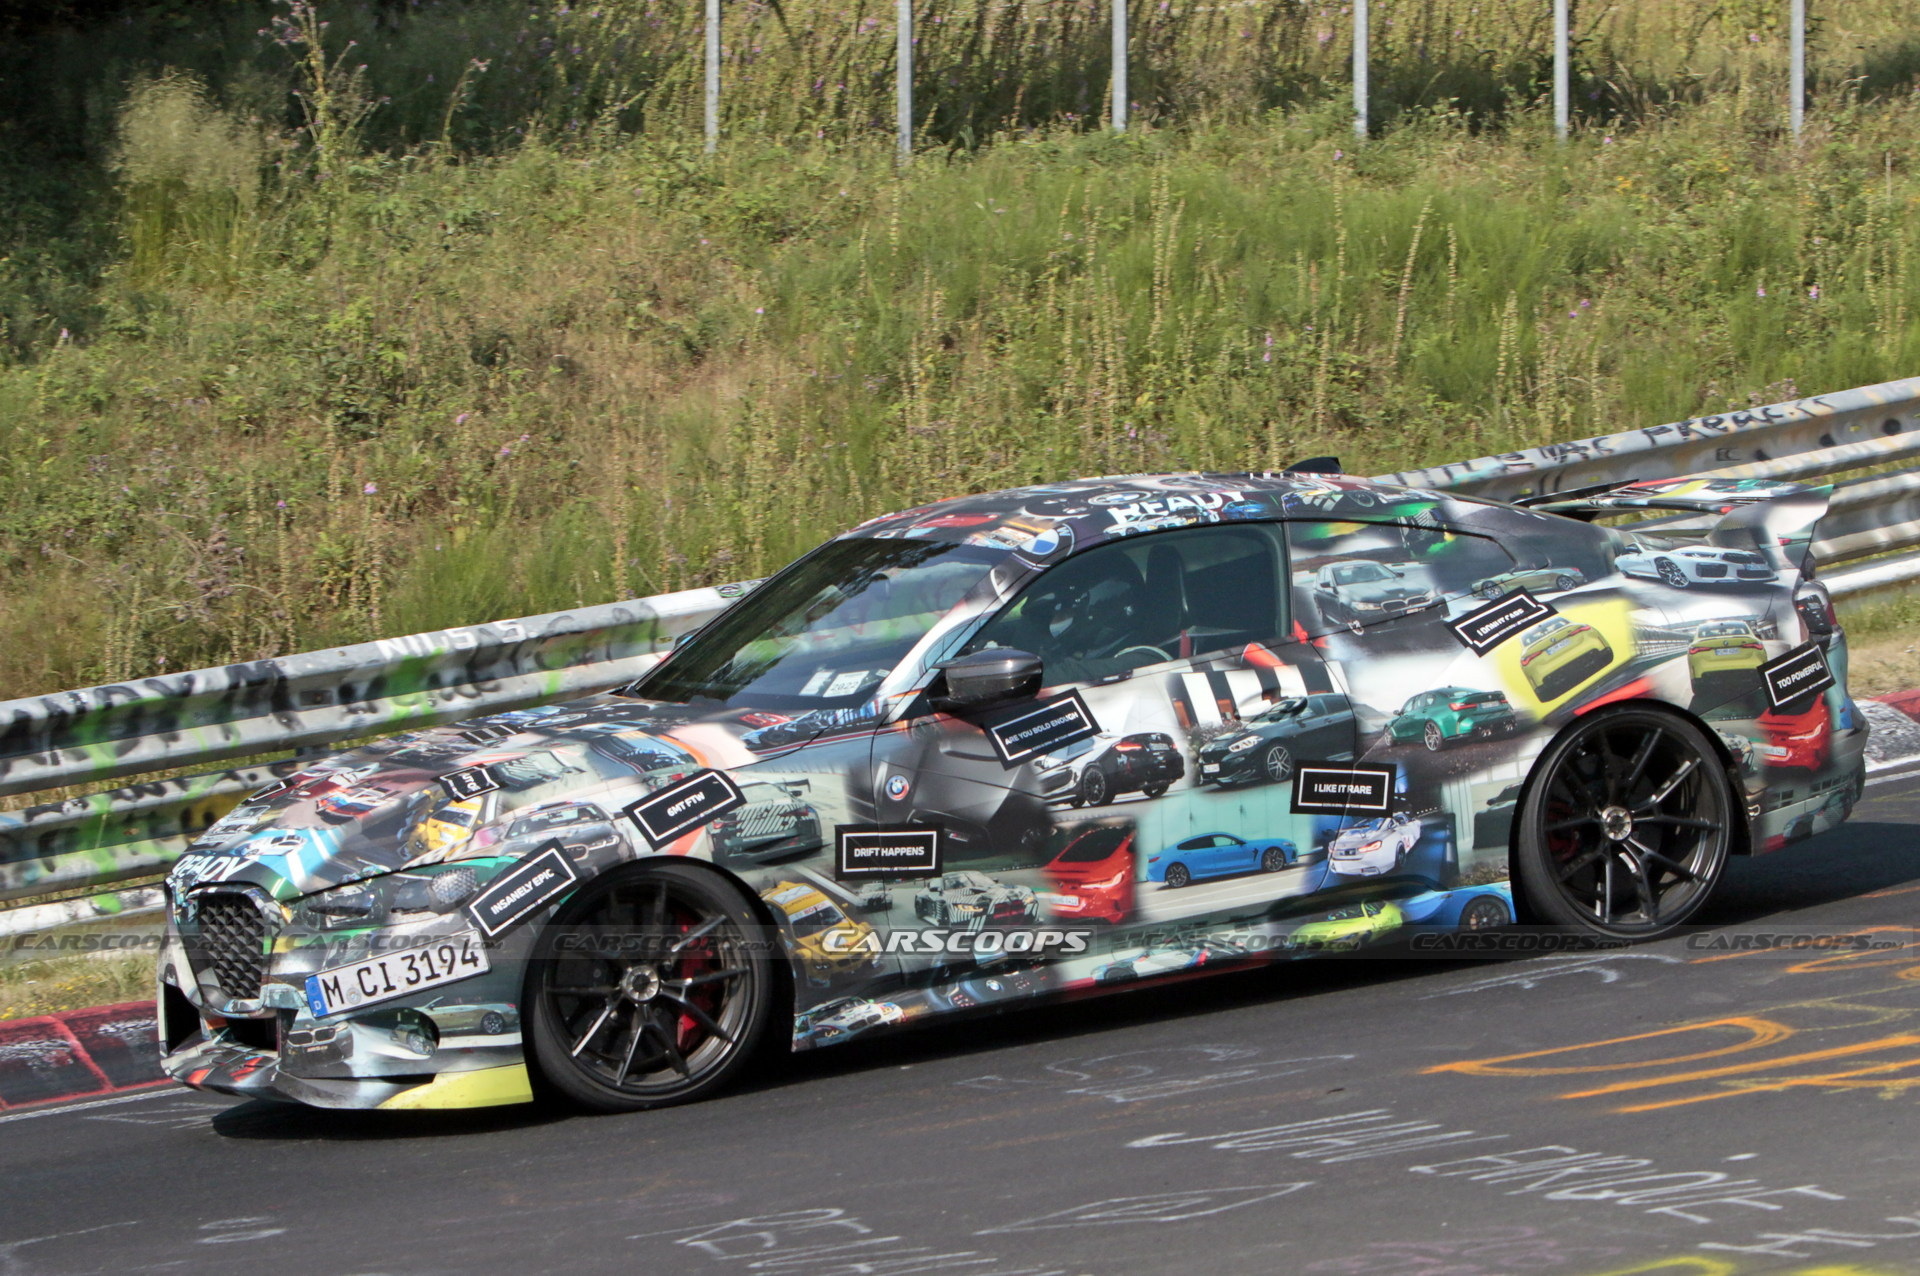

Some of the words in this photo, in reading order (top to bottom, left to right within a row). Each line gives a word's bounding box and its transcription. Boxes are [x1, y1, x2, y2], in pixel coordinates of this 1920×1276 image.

[1776, 676, 1792, 689] TOO
[1791, 661, 1824, 682] POWERFUL
[1004, 736, 1020, 745] ARE
[1019, 729, 1033, 740] YOU
[1033, 722, 1051, 734] BOLD
[1050, 711, 1079, 728] ENOUGH
[1318, 784, 1337, 793] LIKE
[1337, 784, 1346, 793] IT
[1347, 785, 1373, 795] RARE
[667, 800, 687, 817] 6MT
[685, 791, 706, 808] FTW
[854, 847, 881, 857] DRIFT
[881, 846, 925, 857] HAPPENS
[490, 881, 534, 915] INSANELY
[532, 868, 555, 887] EPIC
[321, 975, 345, 1008] M
[356, 962, 397, 997] CI
[400, 938, 480, 986] 3194
